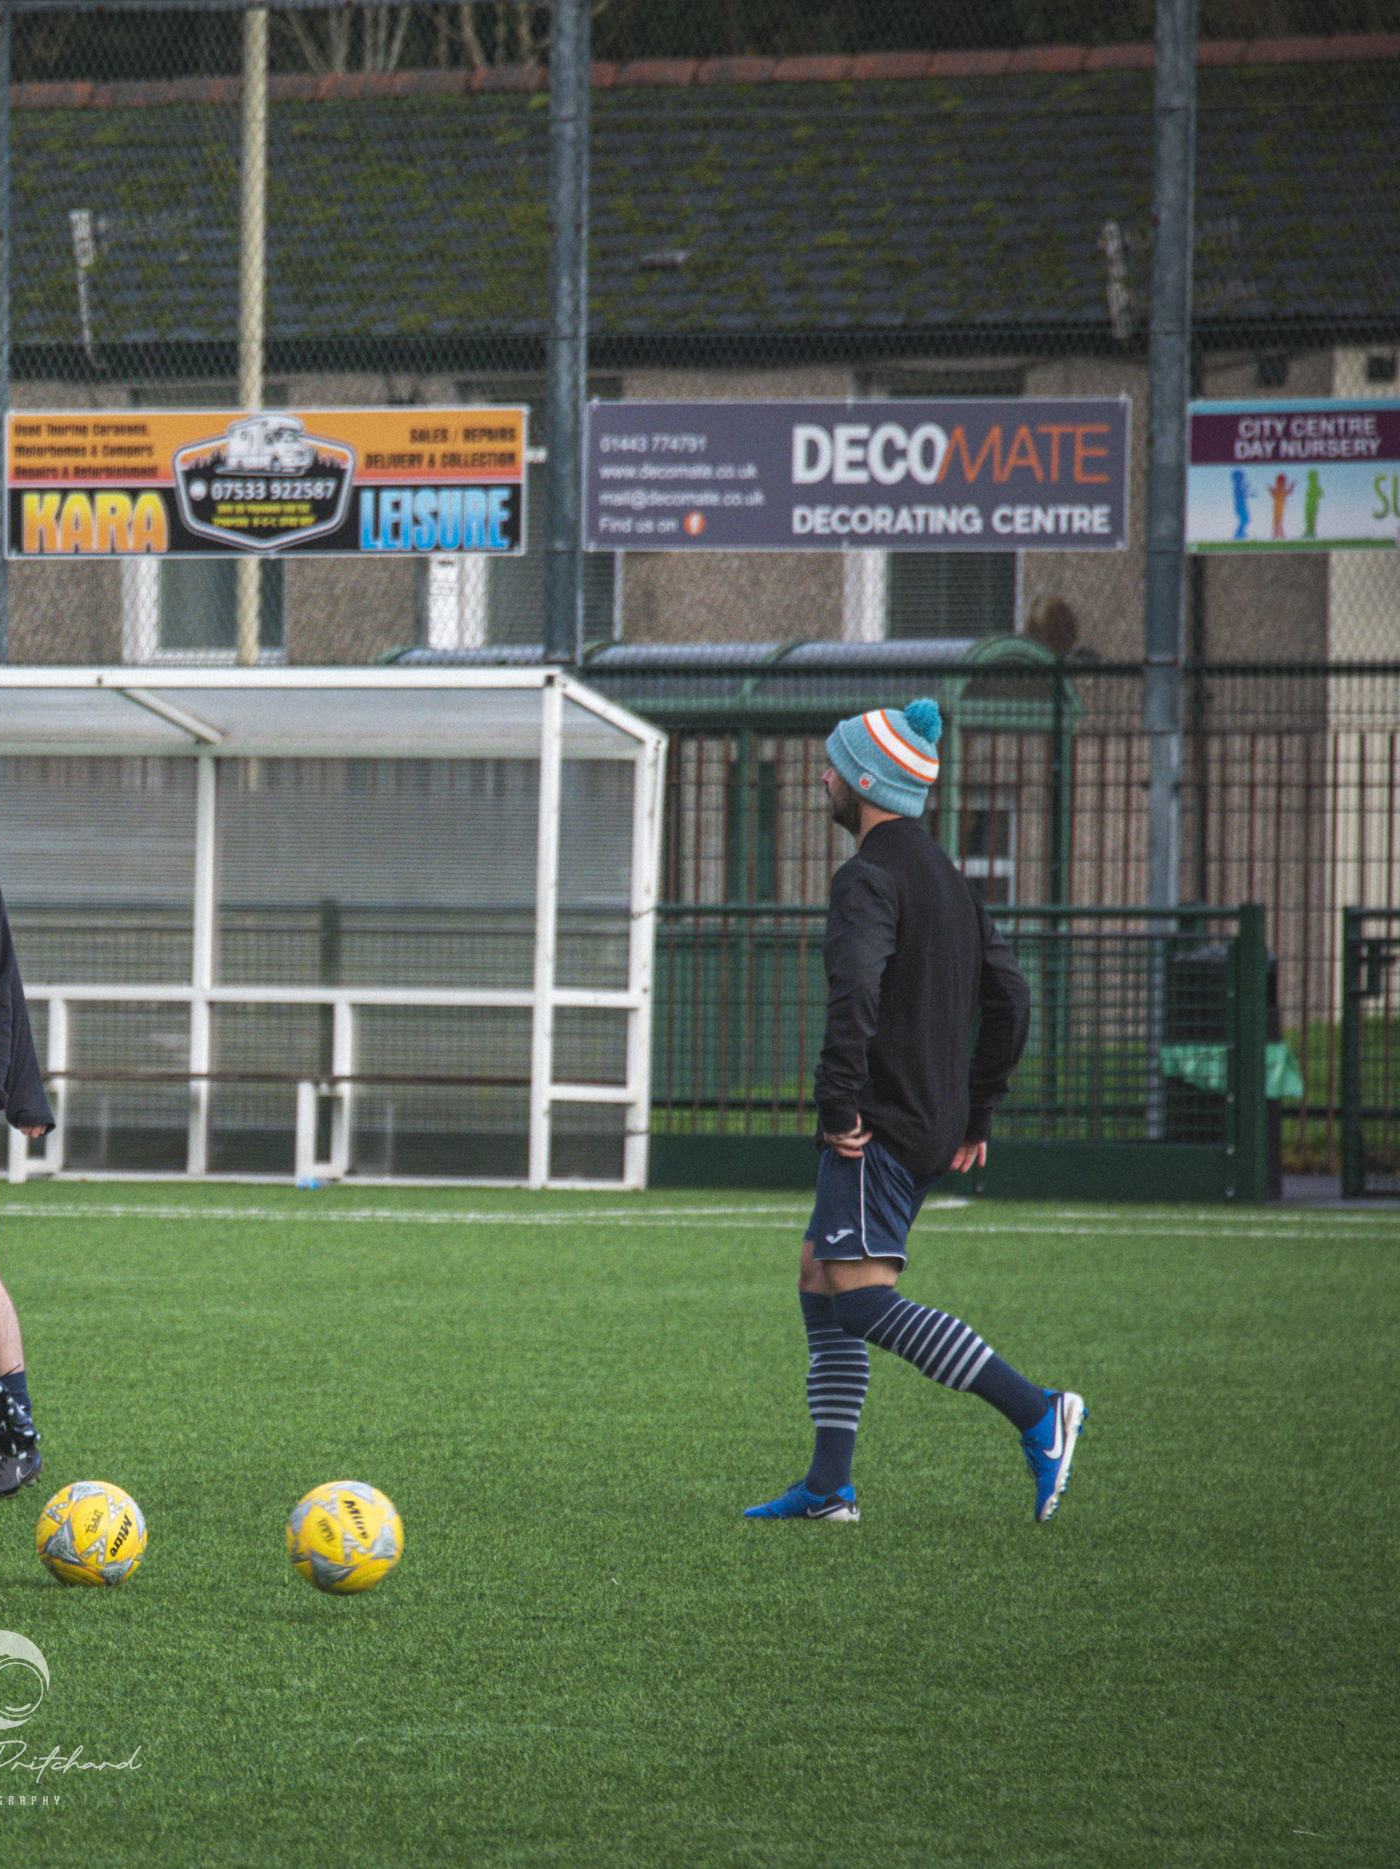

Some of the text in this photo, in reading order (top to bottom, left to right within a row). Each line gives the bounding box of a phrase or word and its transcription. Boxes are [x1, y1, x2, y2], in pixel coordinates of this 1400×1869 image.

[47, 424, 88, 437] Touring
[410, 428, 448, 443] SALES
[463, 427, 516, 442] REPAIRS
[1238, 415, 1378, 438] CITY CENTRE
[14, 445, 86, 458] Motorhomes
[102, 445, 153, 458] Campers
[599, 433, 648, 453] 01443
[792, 421, 1110, 485] DECOMATE
[1234, 437, 1381, 459] DAY NURSERY
[365, 452, 515, 469] DELIVERY & COLLECTION
[599, 463, 758, 480] www.decomate.co.uk
[211, 478, 337, 500] 07533 922587
[22, 490, 169, 553] KARA
[360, 486, 512, 551] LEISURE
[599, 514, 632, 533] Find
[635, 519, 654, 533] us
[657, 518, 678, 533] on
[792, 503, 1111, 534] DECORATING CENTRE
[110, 1513, 132, 1557] Mitre
